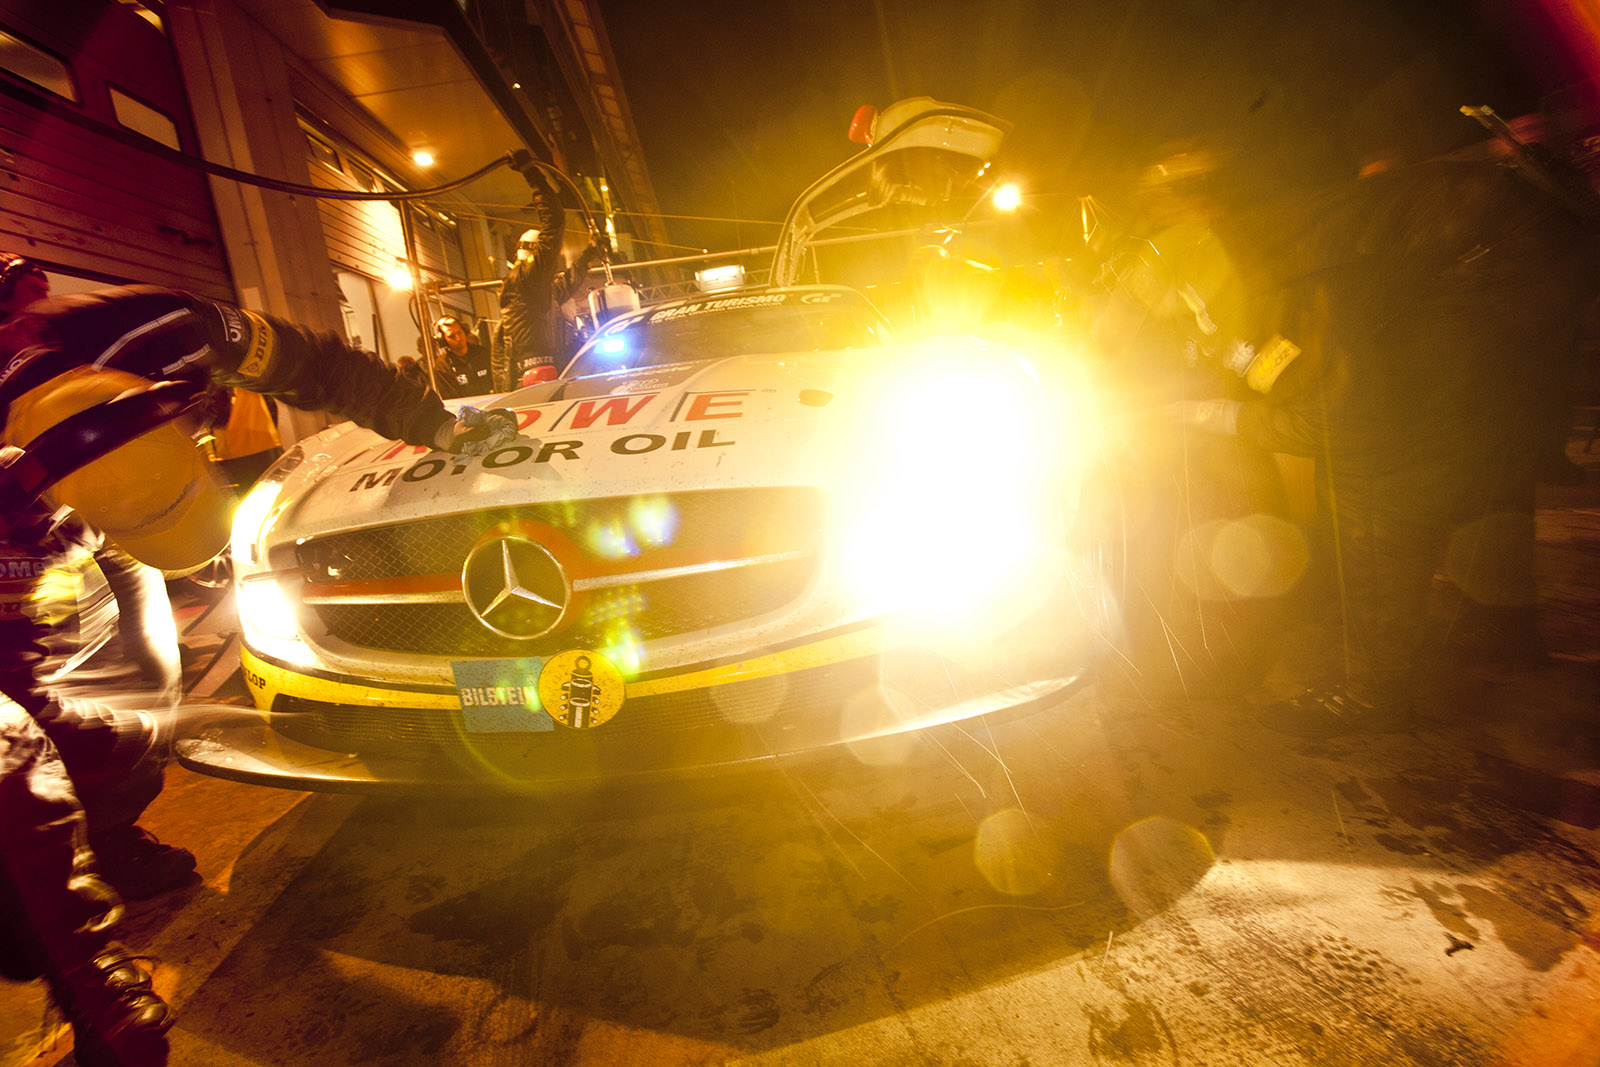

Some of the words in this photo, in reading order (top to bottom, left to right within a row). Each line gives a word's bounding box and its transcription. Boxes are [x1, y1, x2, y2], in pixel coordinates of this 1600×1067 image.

[650, 303, 702, 321] GRAN
[705, 294, 787, 309] TURISMO
[381, 392, 750, 461] WE
[610, 429, 736, 456] OIL
